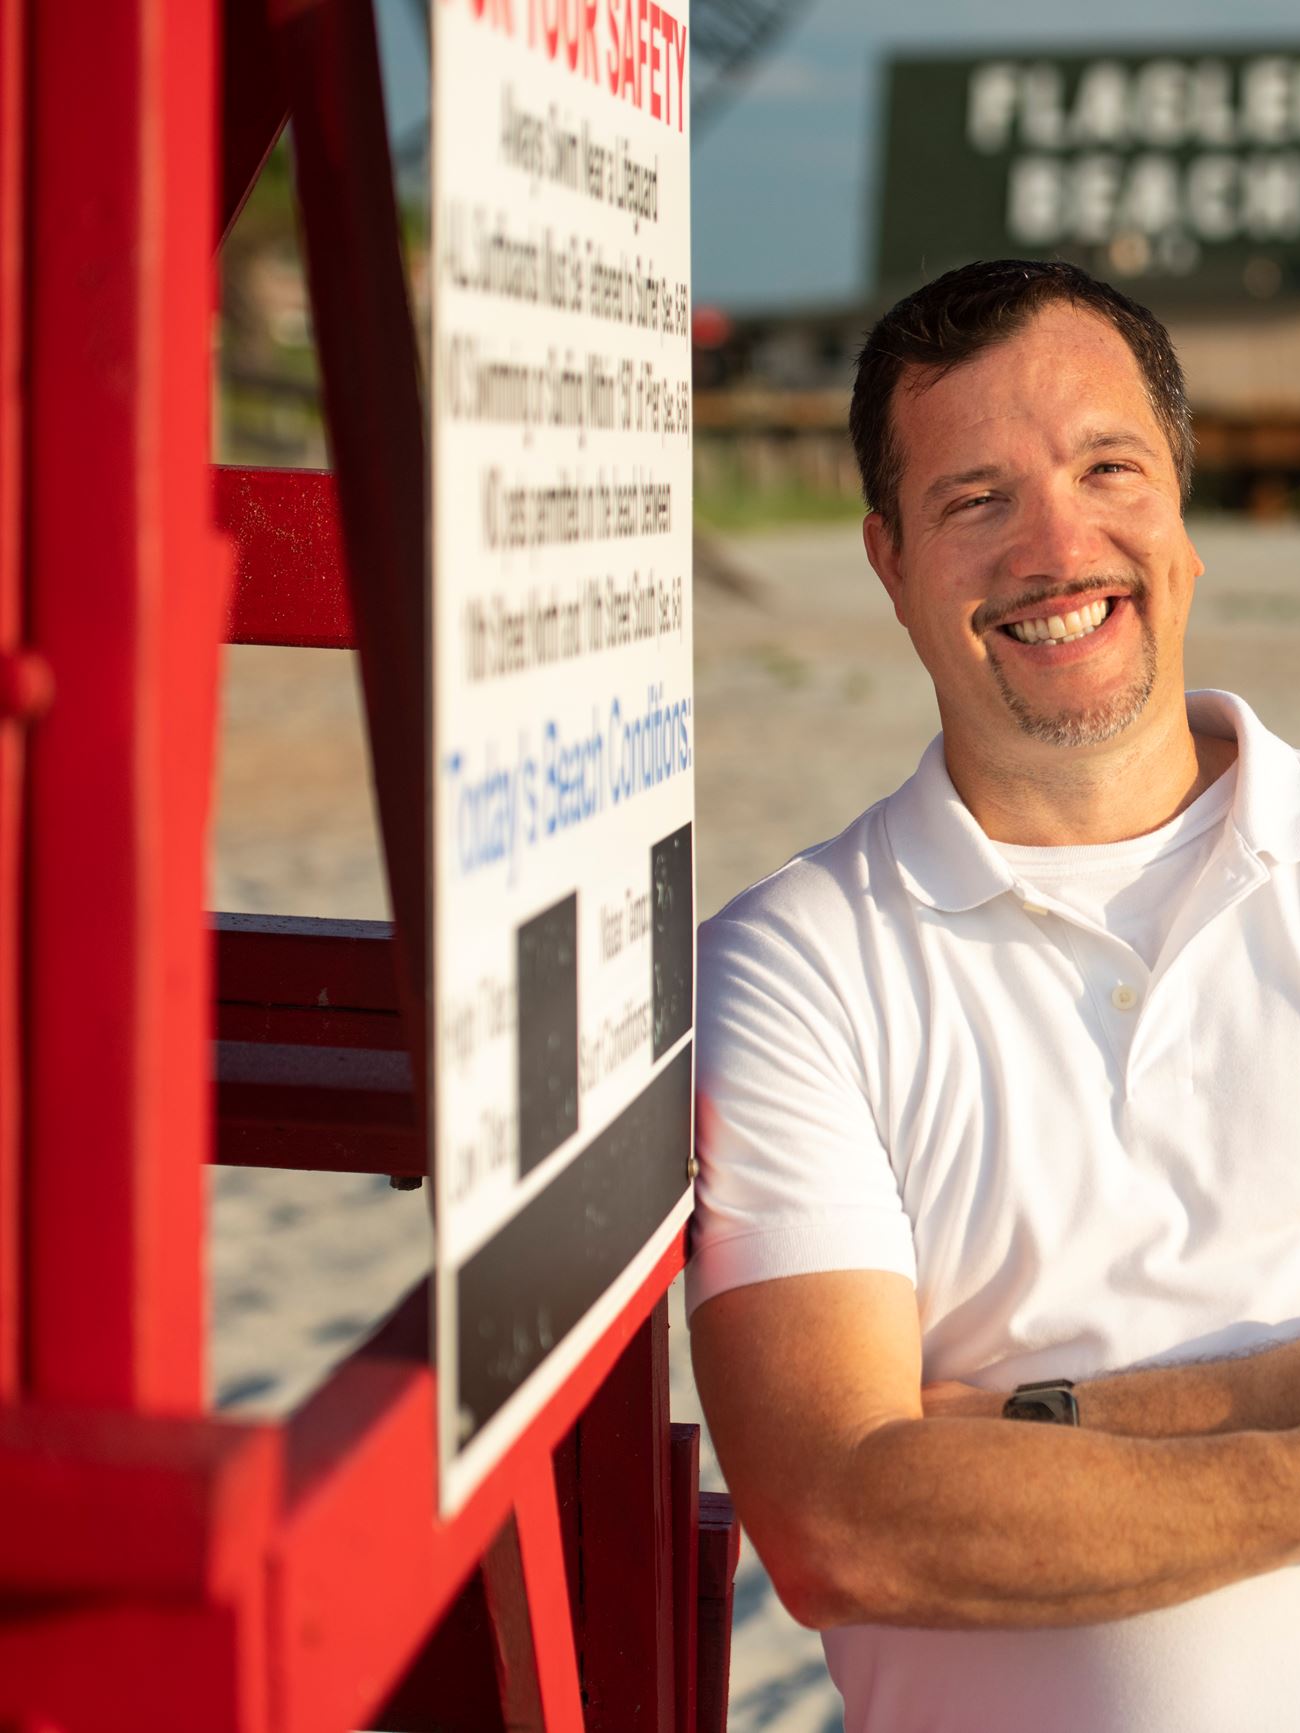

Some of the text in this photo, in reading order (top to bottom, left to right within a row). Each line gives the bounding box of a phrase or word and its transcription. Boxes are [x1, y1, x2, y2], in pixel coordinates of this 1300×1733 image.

[607, 0, 687, 133] SAFETY
[548, 101, 578, 192] Swim
[582, 118, 604, 203] Near
[615, 134, 658, 235] Lifeguard
[585, 238, 623, 323] Tethered
[635, 254, 658, 331] Surfer
[645, 361, 660, 433] Pier
[613, 463, 638, 538] beach
[640, 464, 671, 535] between
[606, 573, 630, 648] Street
[632, 568, 655, 642] South
[442, 680, 692, 888] Today's Beach Conditions:
